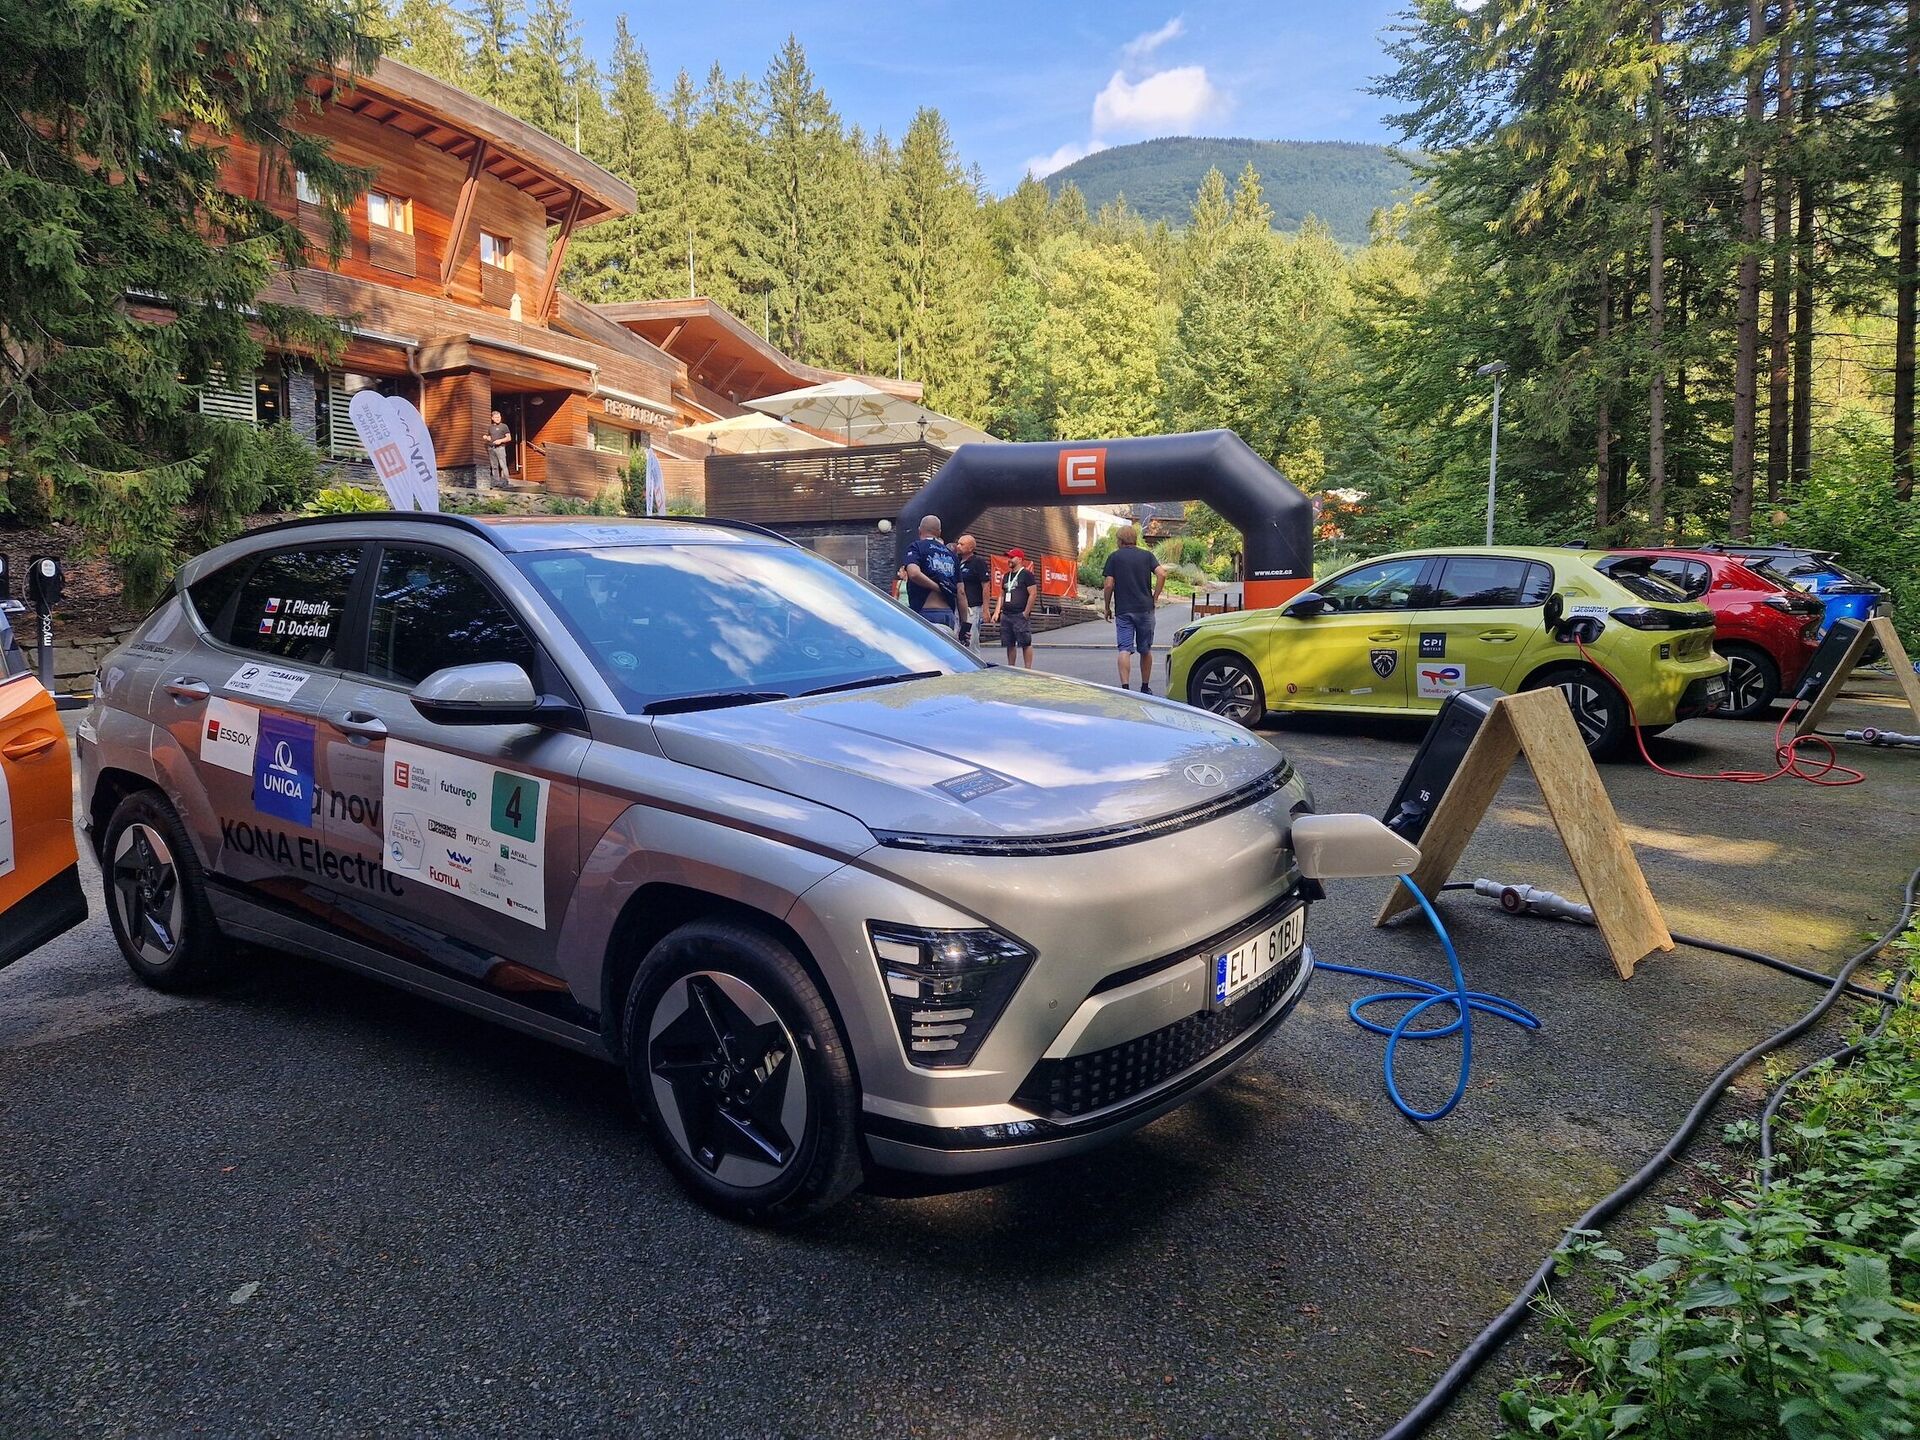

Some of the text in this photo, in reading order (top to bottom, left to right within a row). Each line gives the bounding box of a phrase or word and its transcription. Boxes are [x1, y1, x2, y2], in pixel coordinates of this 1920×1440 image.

[292, 600, 330, 616] Plesník
[276, 620, 330, 638] D. Dočekal
[219, 728, 252, 747] ESSOX
[263, 773, 303, 799] UNIQA
[1420, 789, 1431, 802] 15
[329, 789, 383, 827] nov
[505, 786, 522, 829] 4
[219, 816, 406, 897] KONA Electric
[429, 865, 461, 890] FLOTILA
[1216, 982, 1226, 996] CZ
